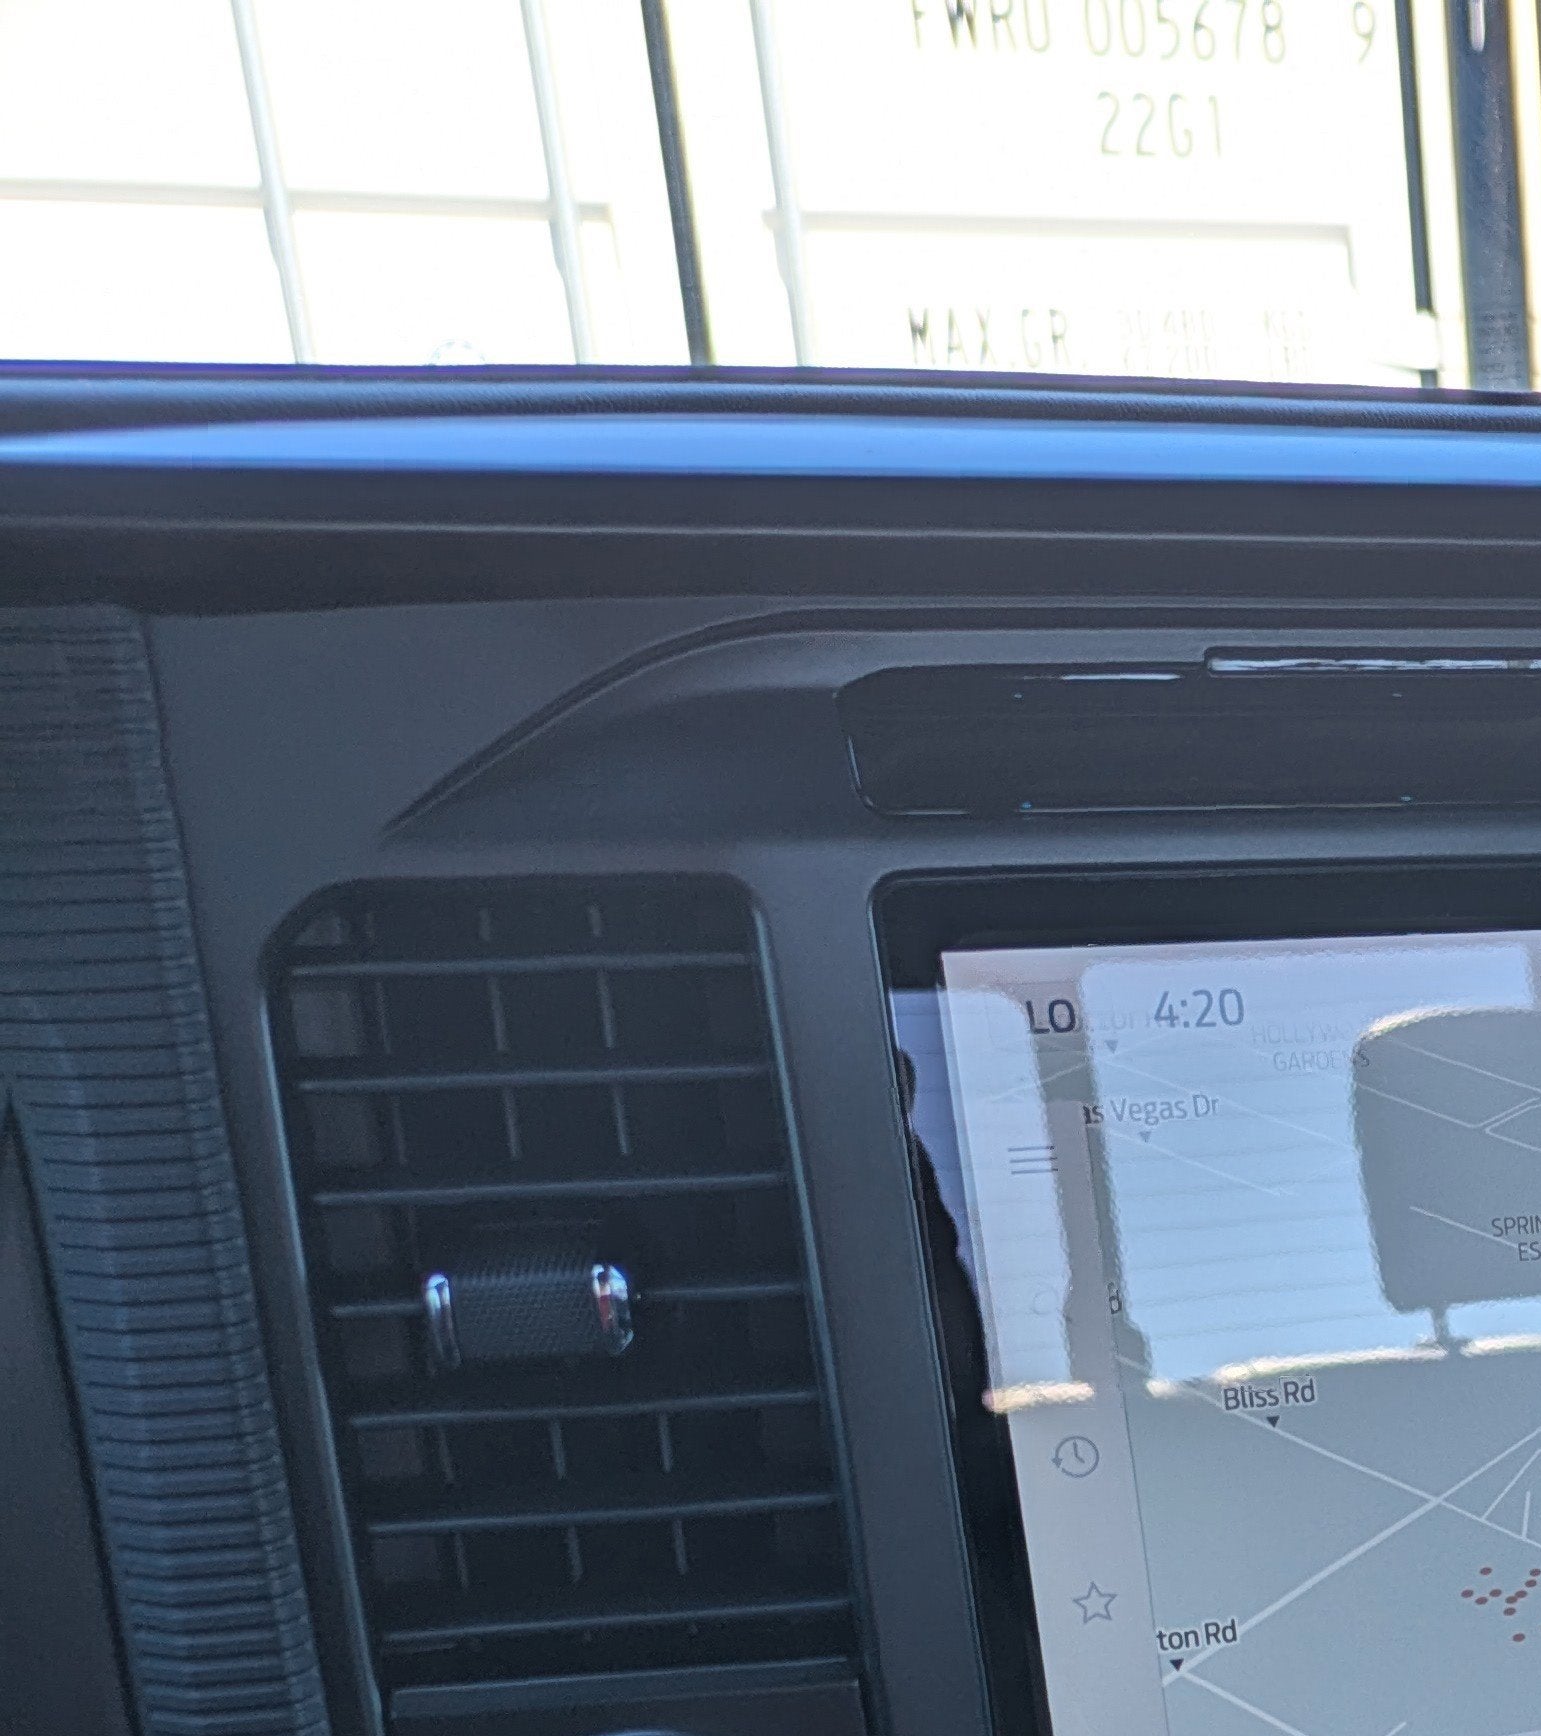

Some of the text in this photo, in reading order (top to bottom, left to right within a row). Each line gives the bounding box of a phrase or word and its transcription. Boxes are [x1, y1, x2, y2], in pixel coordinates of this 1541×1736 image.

[1083, 0, 1287, 64] 005678
[1351, 1, 1377, 64] 9
[1097, 92, 1223, 158] 22G1
[1026, 998, 1077, 1035] LO
[1153, 988, 1245, 1029] 4:20
[1110, 1097, 1187, 1126] Vegas
[1192, 1094, 1219, 1118] Dr
[1223, 1378, 1316, 1412] Bliss Rd
[1204, 1620, 1238, 1645] Rd
